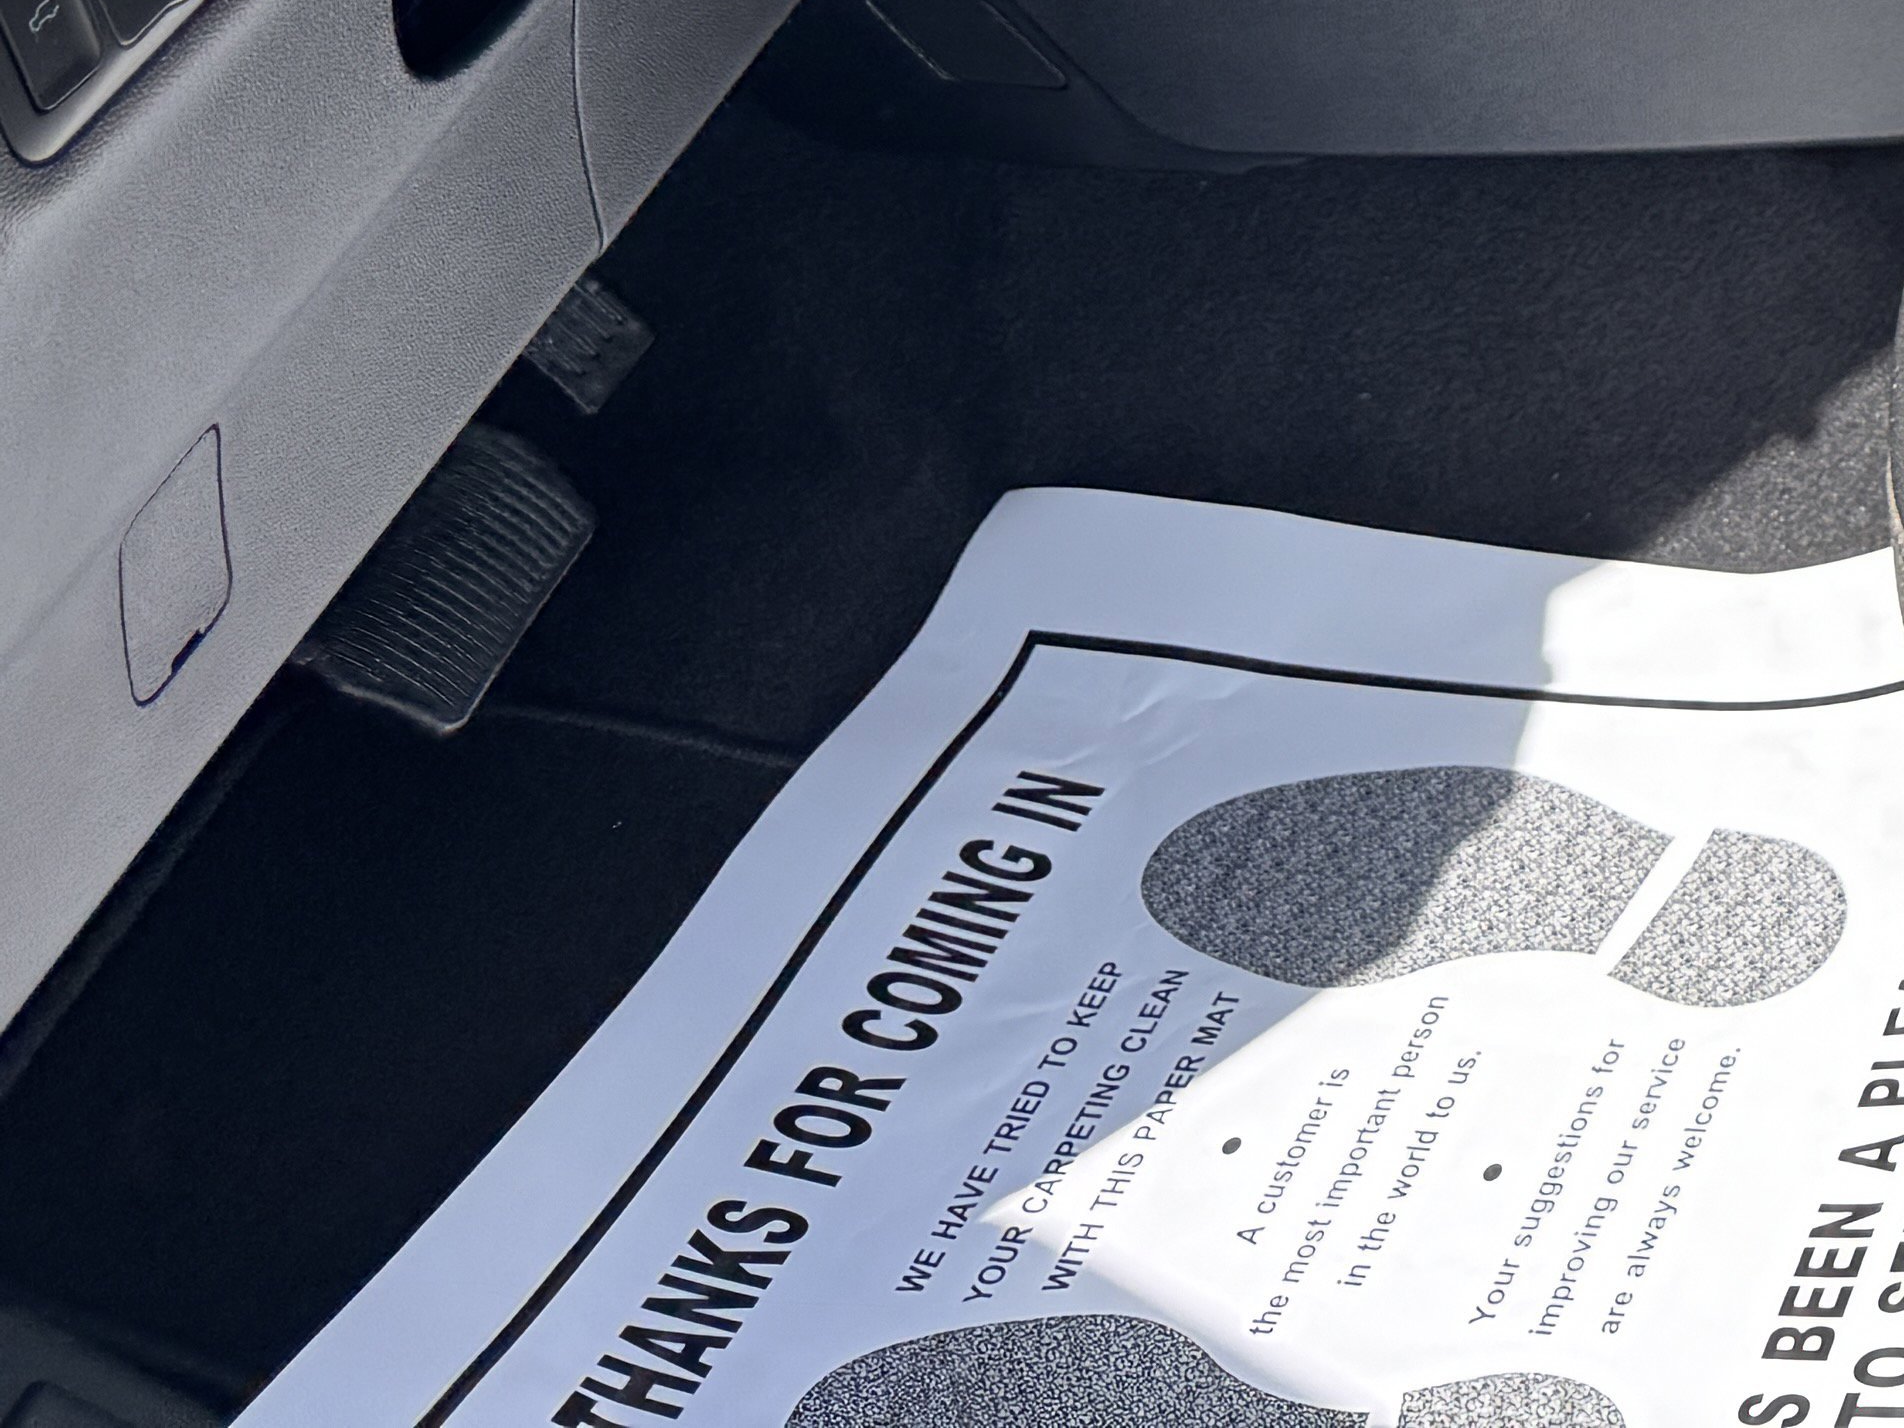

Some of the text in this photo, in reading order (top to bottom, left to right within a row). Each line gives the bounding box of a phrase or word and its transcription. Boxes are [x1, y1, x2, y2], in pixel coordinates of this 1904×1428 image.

[551, 770, 1105, 1428] THANKS FOR COMING IN
[895, 961, 1124, 1293] WE HAVE TRIED TO KEEP
[961, 969, 1190, 1303] YOUR CARPETING CLEAN
[1041, 991, 1240, 1292] WITH THIS PAPER MAT
[1236, 1067, 1350, 1245] A customer is
[1249, 995, 1449, 1336] the most important person
[1336, 1050, 1482, 1287] in the world to us.
[1468, 1038, 1625, 1325] Your suggestions for
[1528, 1038, 1686, 1336] improving our service
[1601, 1047, 1741, 1334] are always welcome.
[1761, 1202, 1884, 1361] BEEN
